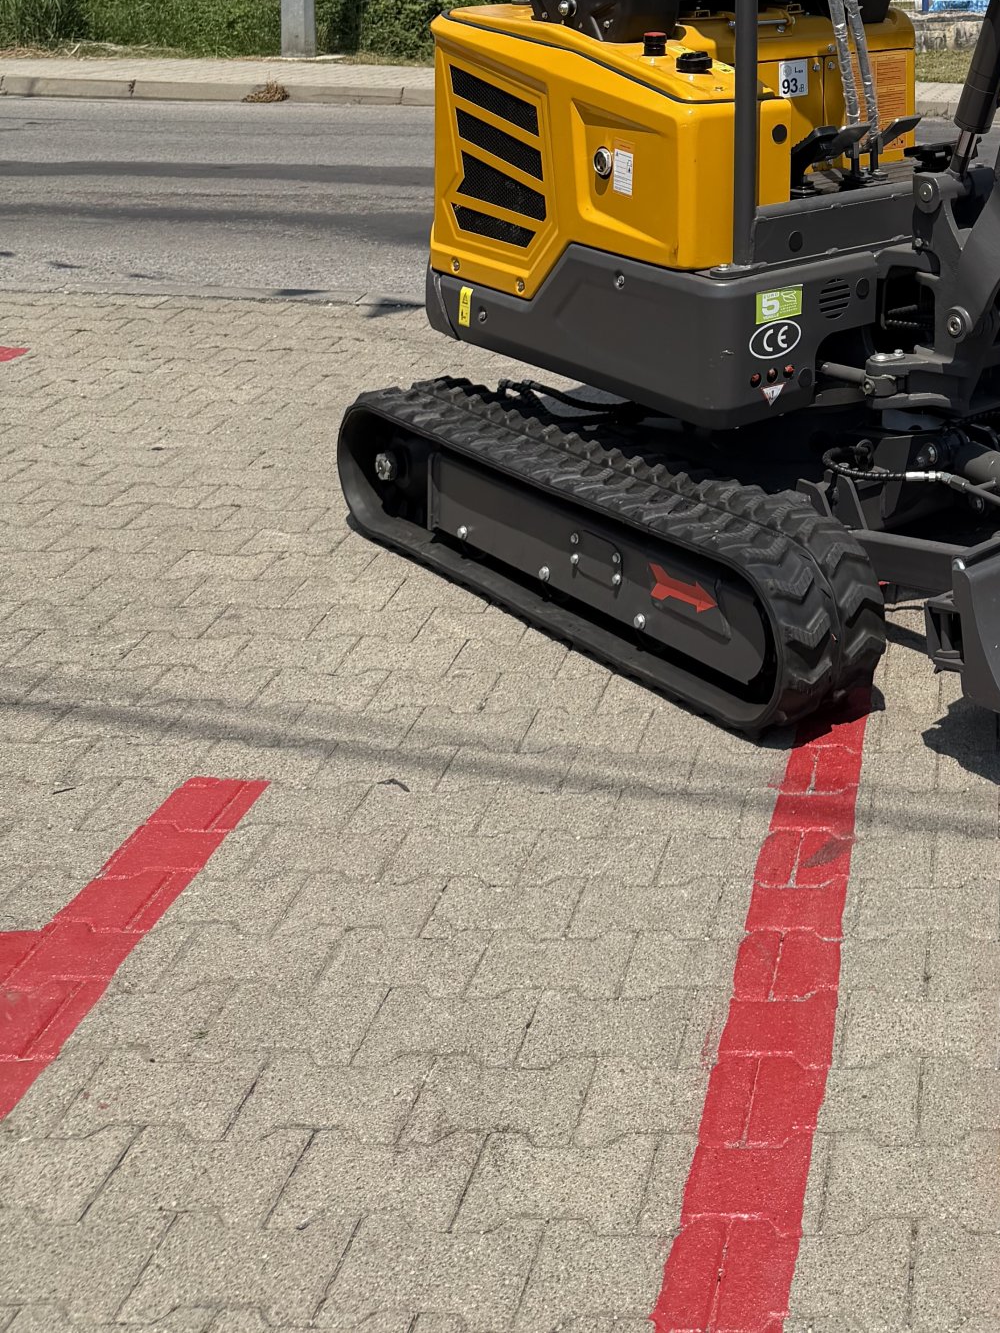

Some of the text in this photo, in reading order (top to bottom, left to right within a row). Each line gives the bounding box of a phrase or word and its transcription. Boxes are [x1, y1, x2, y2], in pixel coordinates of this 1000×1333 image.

[781, 77, 798, 95] 93
[761, 291, 780, 316] 5
[762, 325, 789, 352] CE
